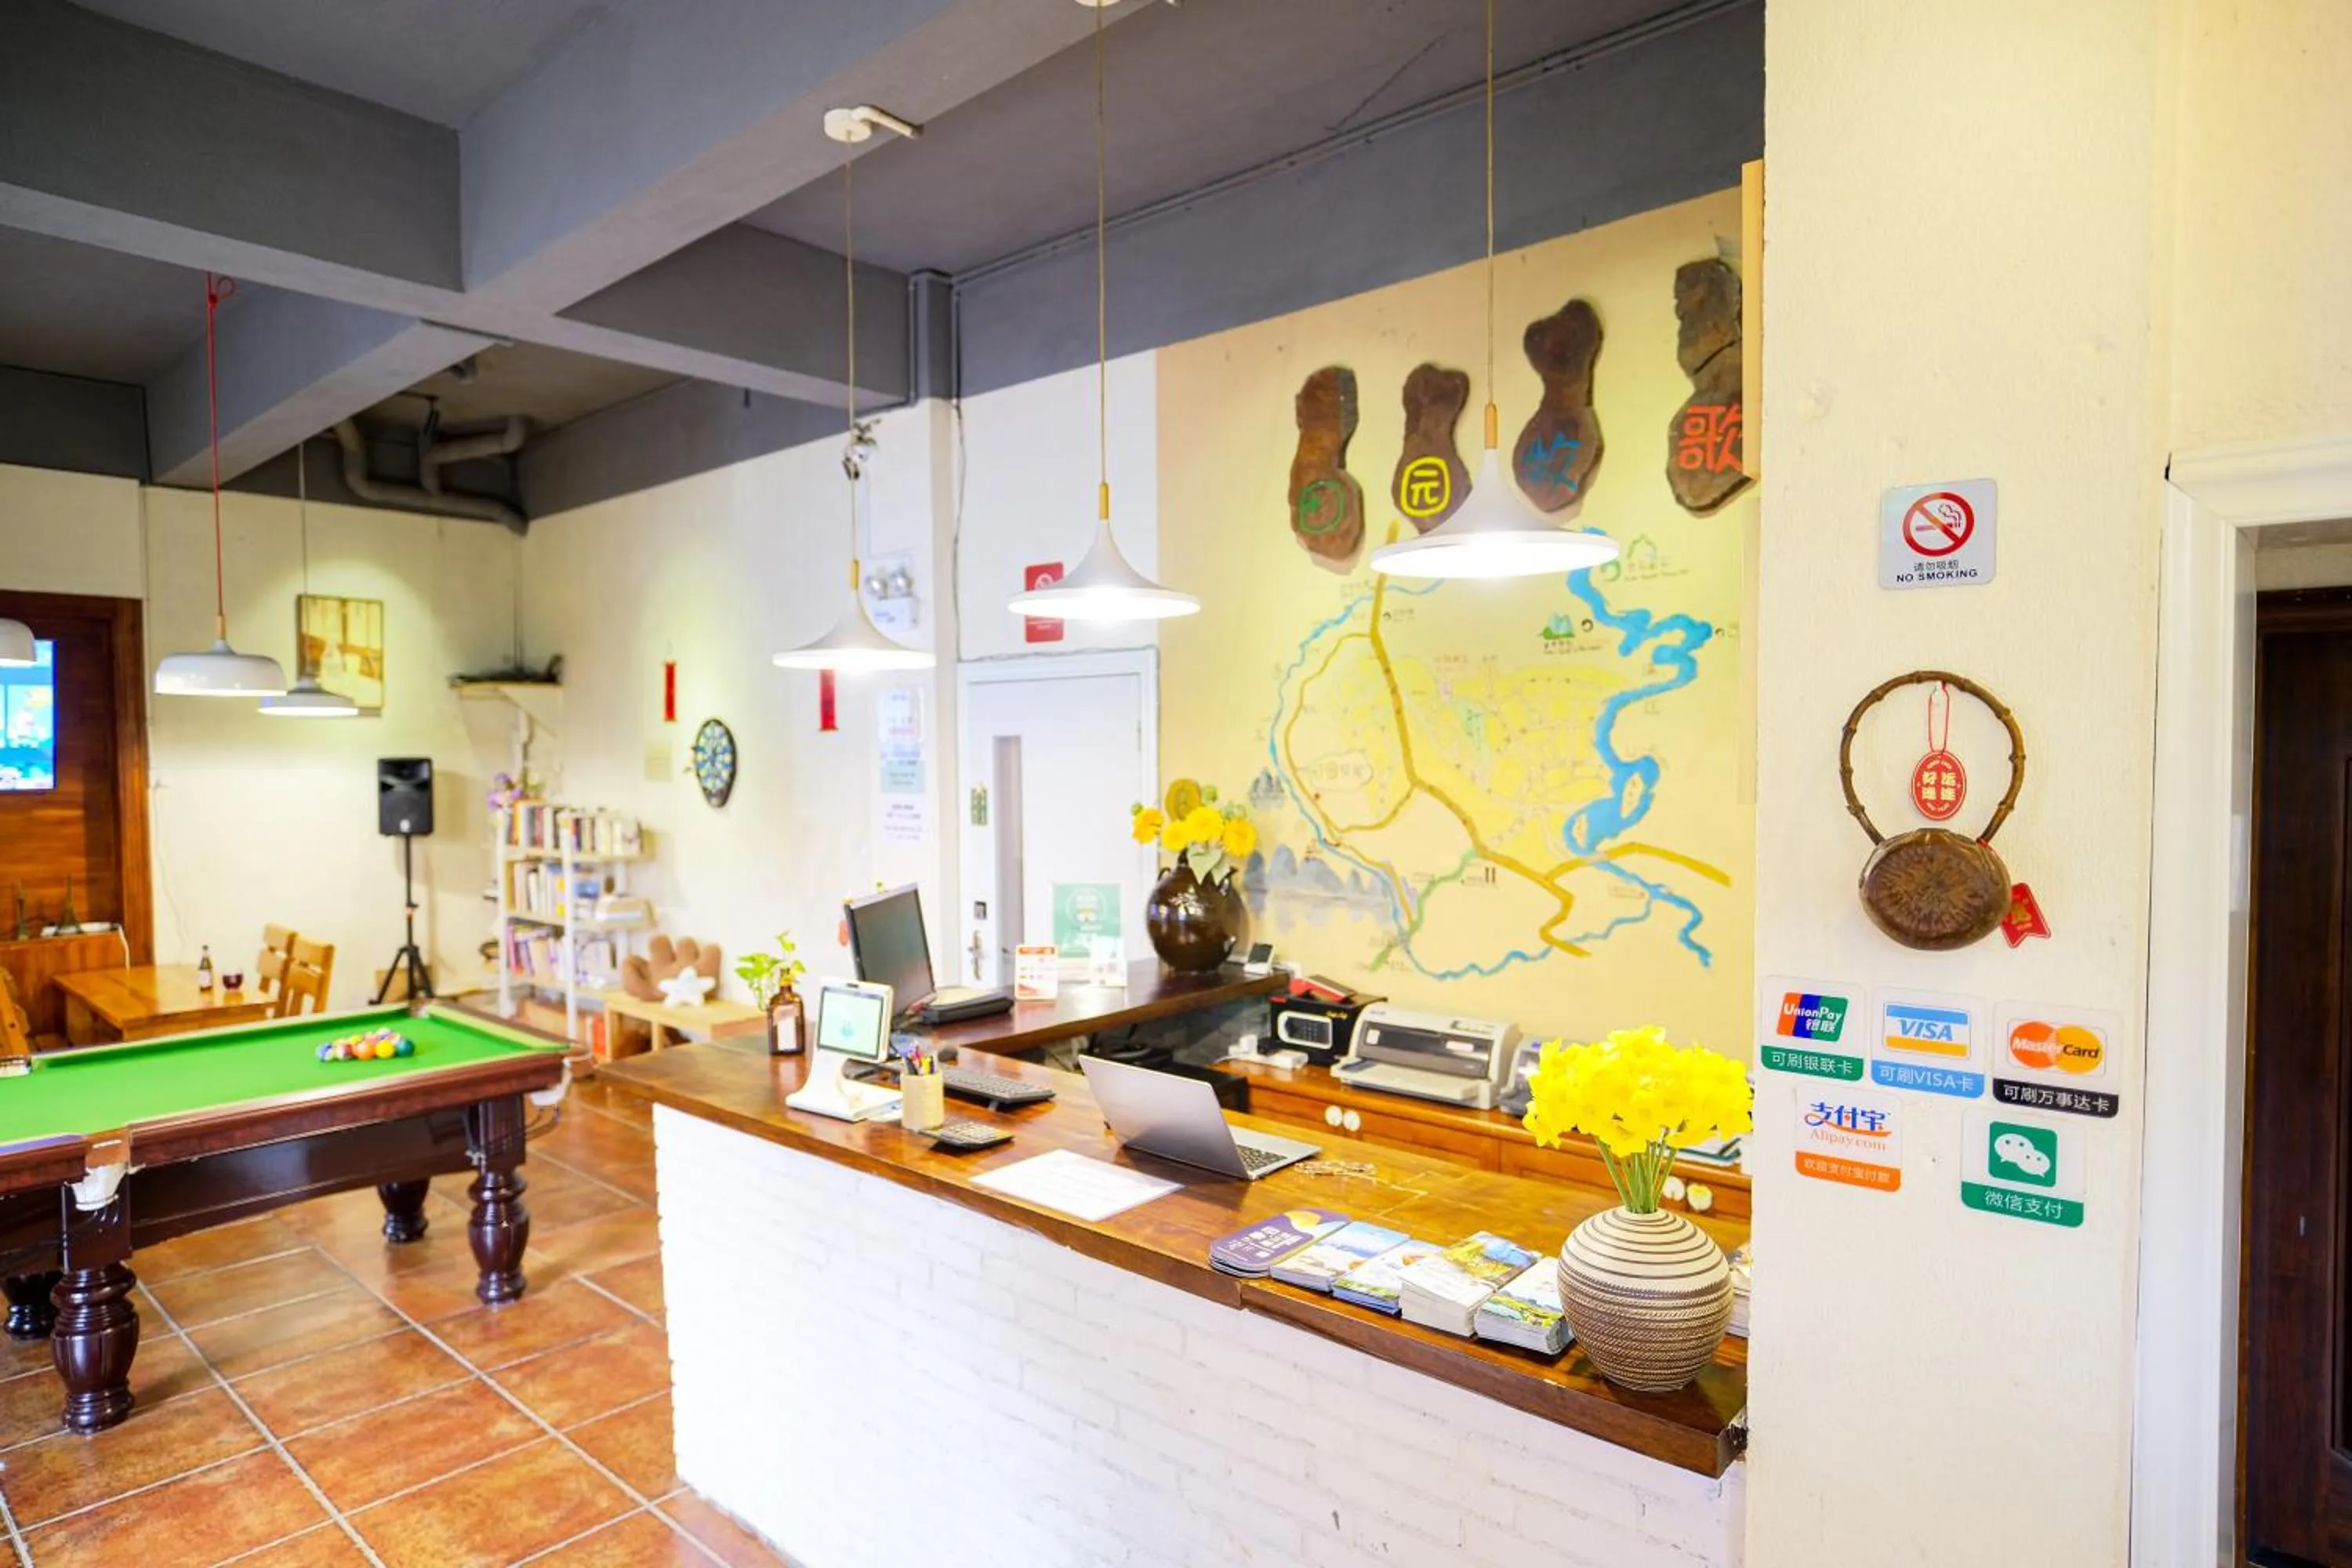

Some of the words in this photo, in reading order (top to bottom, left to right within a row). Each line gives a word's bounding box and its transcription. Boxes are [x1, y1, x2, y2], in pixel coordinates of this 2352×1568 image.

[1896, 573, 1914, 583] NO
[1918, 568, 1978, 581] SMOKING
[1784, 1004, 1842, 1024] UnionPay
[1806, 1018, 1835, 1033] 银联
[1898, 1018, 1953, 1041] VISA
[2012, 1036, 2100, 1059] MasterCard
[1771, 1051, 1853, 1074] 可刷银联卡
[1881, 1066, 1974, 1092] 可刷VISA卡
[2004, 1084, 2110, 1113] 可刷万事达卡
[1805, 1102, 1887, 1132] 支付宝
[1984, 1190, 2063, 1220] 微信支付
